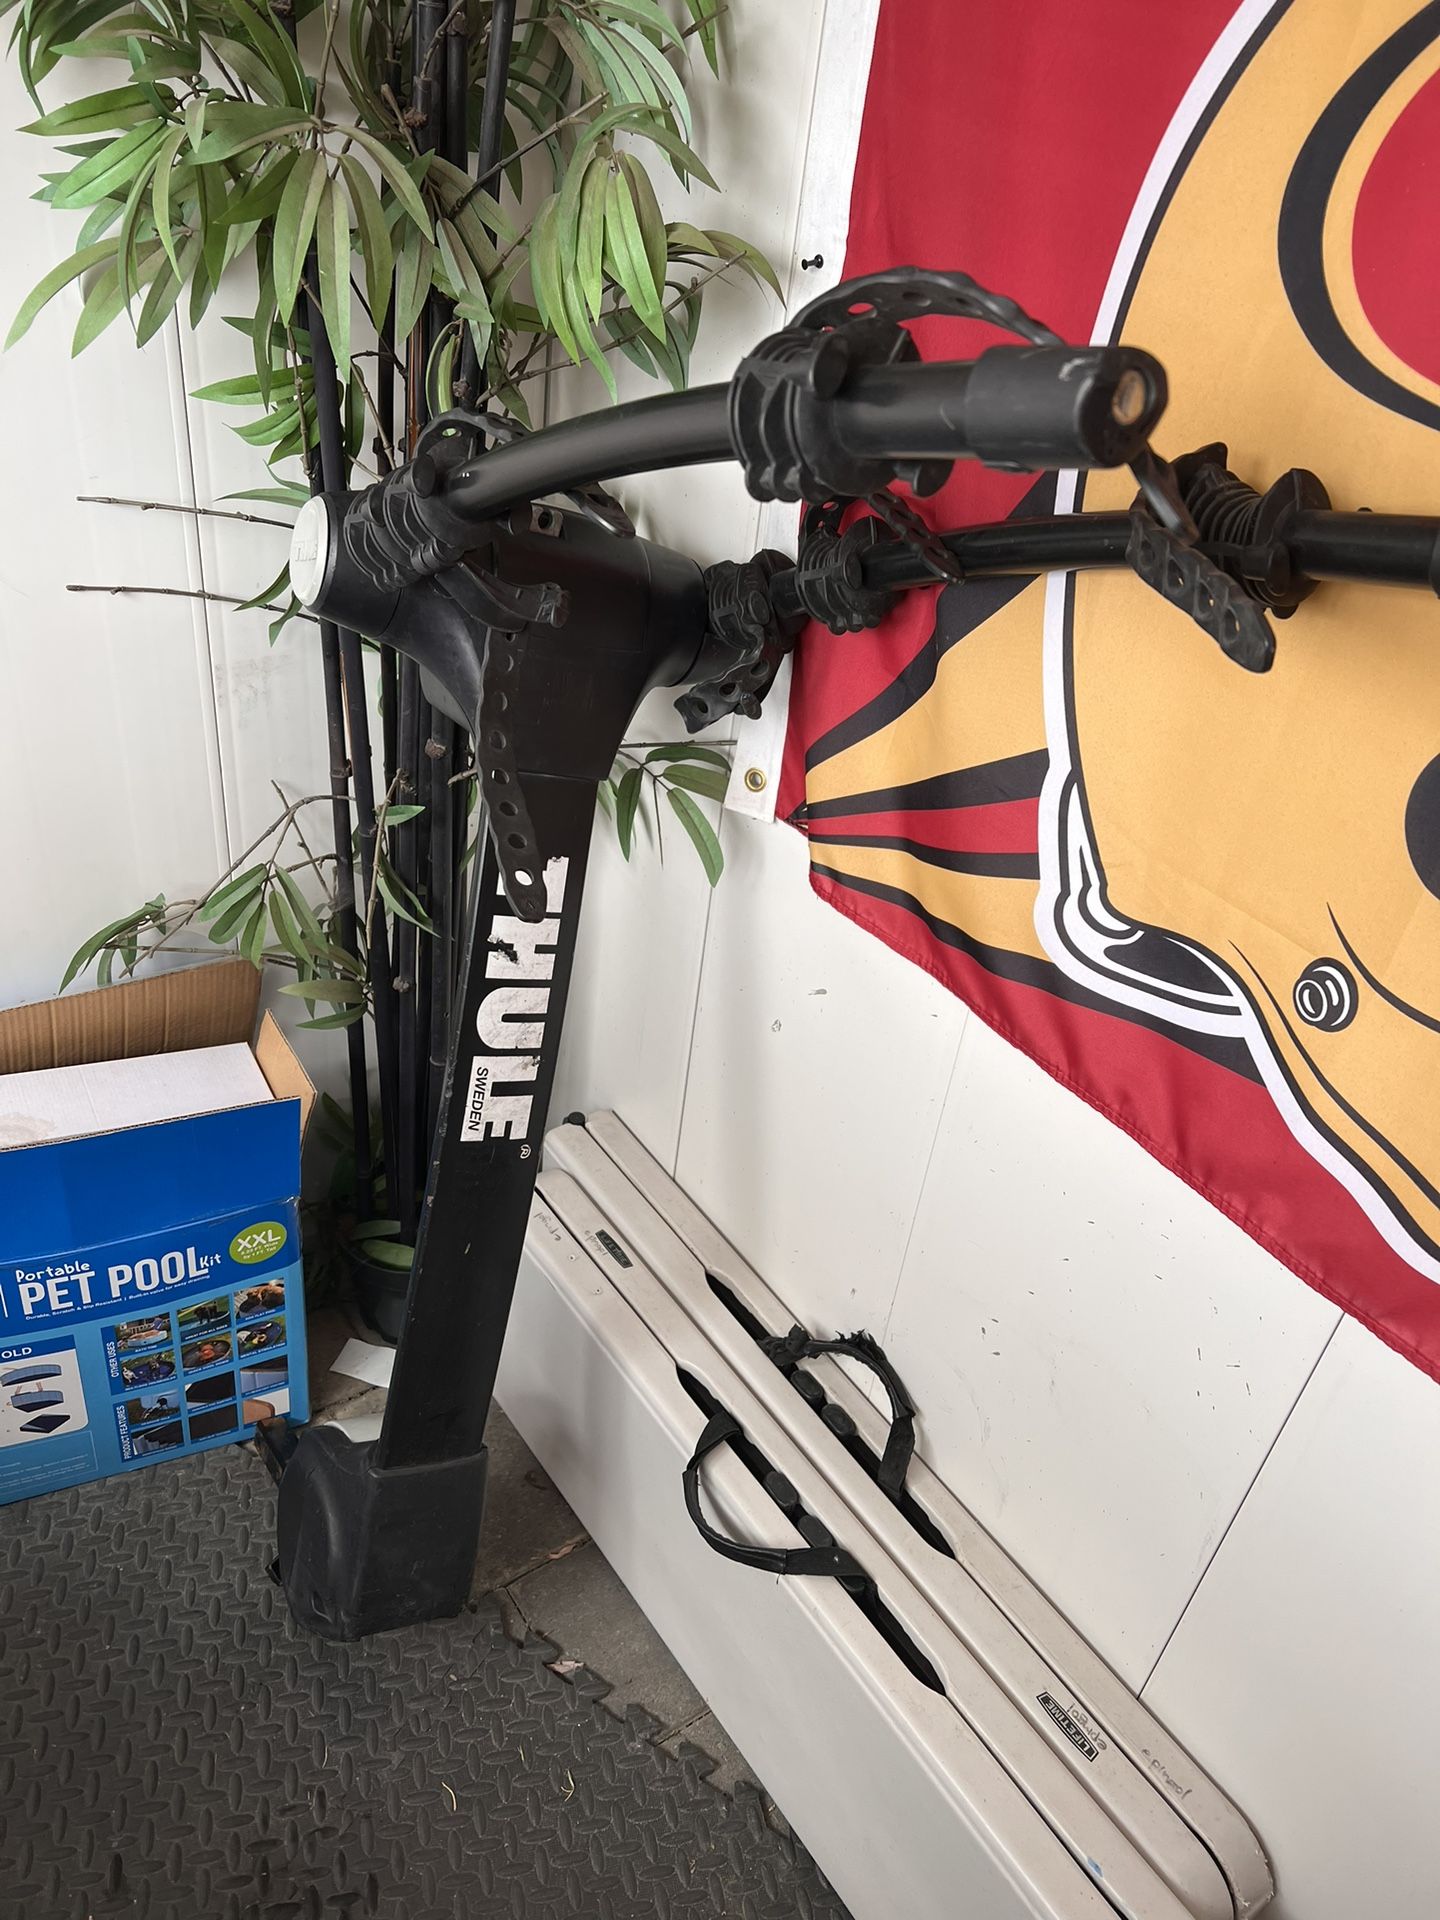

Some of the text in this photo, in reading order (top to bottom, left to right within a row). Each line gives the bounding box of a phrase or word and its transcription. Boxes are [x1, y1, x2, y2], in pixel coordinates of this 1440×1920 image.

[468, 1066, 489, 1131] SWEDEN
[237, 1229, 281, 1252] XXL
[15, 1260, 91, 1283] Portable
[18, 1246, 222, 1316] PET POOL Kit
[1, 1346, 33, 1359] OLD
[106, 1341, 119, 1378] OTHER USES
[116, 1404, 132, 1460] PRODUCT FEATURES
[1045, 1699, 1092, 1753] LIFETIME
